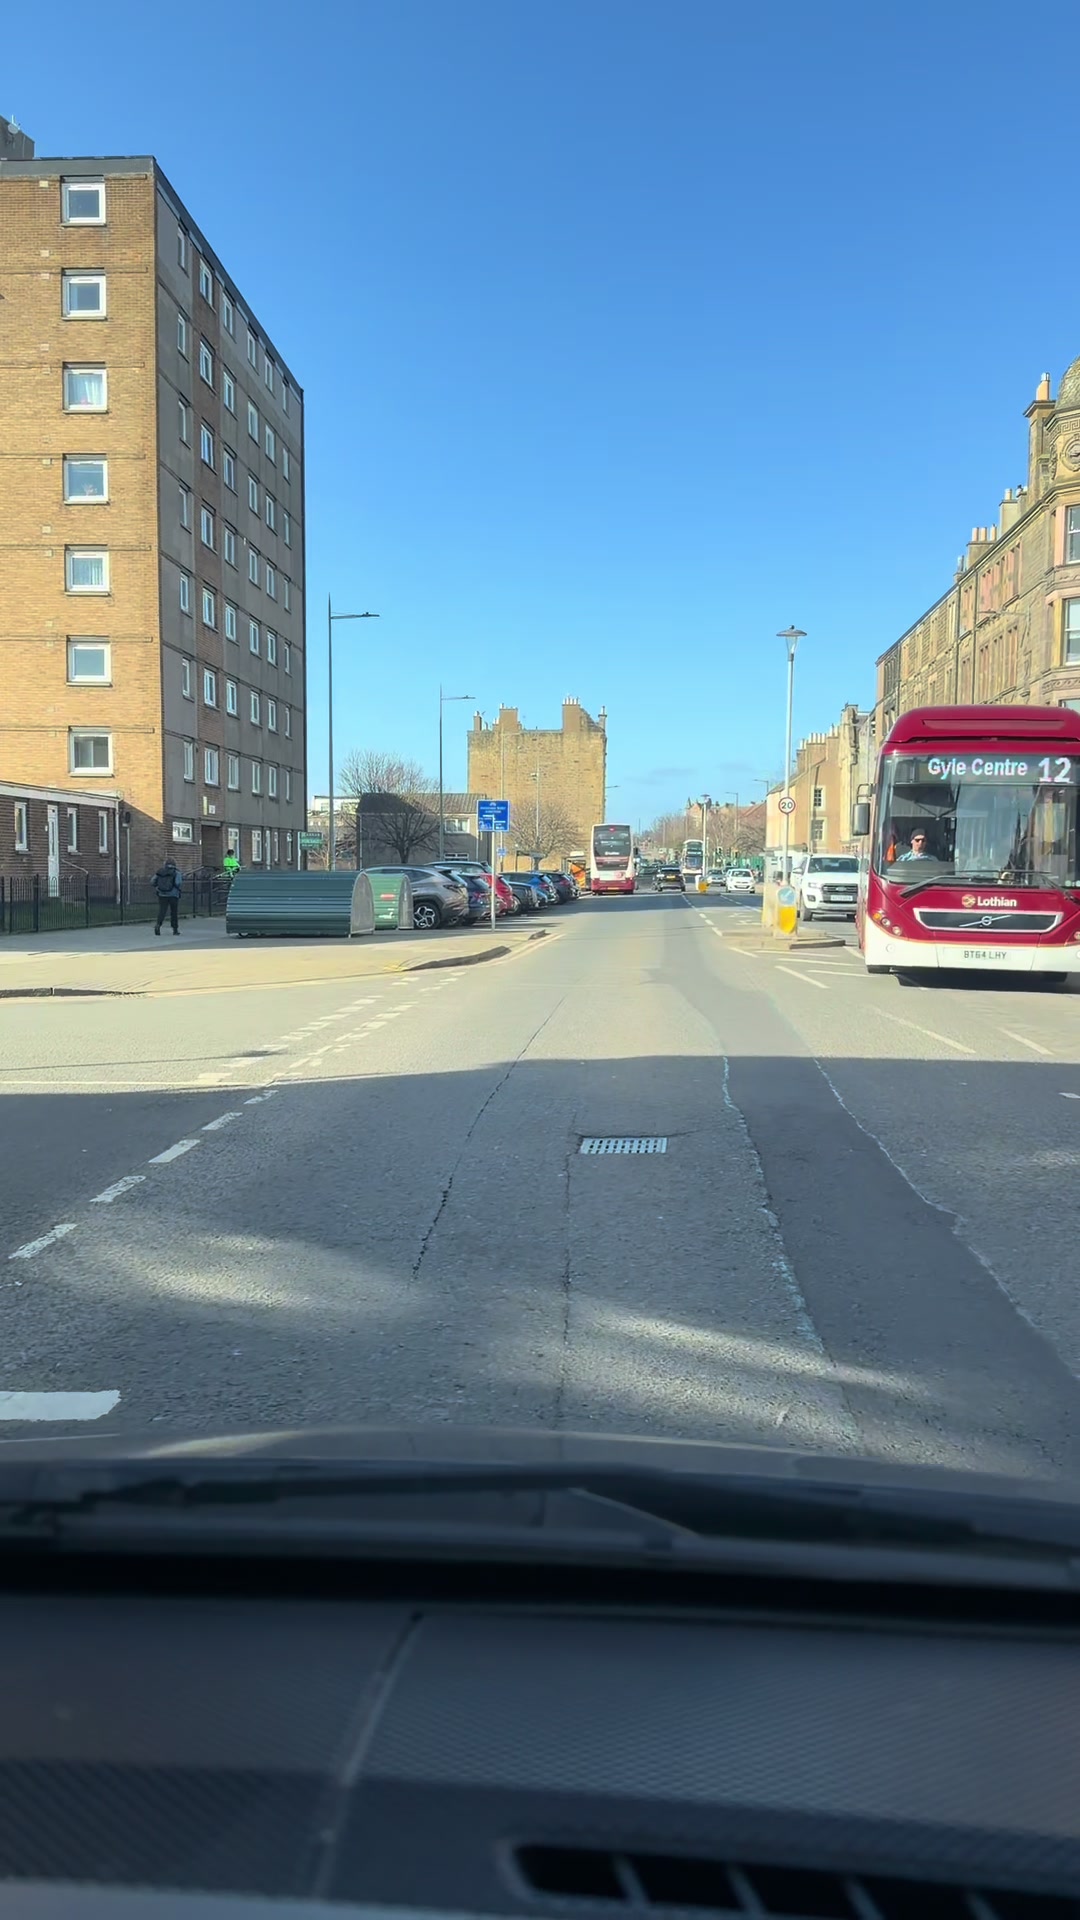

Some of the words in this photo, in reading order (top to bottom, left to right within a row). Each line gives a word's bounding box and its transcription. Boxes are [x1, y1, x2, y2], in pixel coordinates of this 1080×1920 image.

[928, 758, 966, 780] Gyle
[971, 758, 1028, 776] Centre
[1038, 757, 1073, 783] 12
[781, 801, 793, 809] 20
[977, 896, 1017, 907] Lothian
[963, 950, 986, 959] BT64
[988, 951, 1007, 960] LHY
